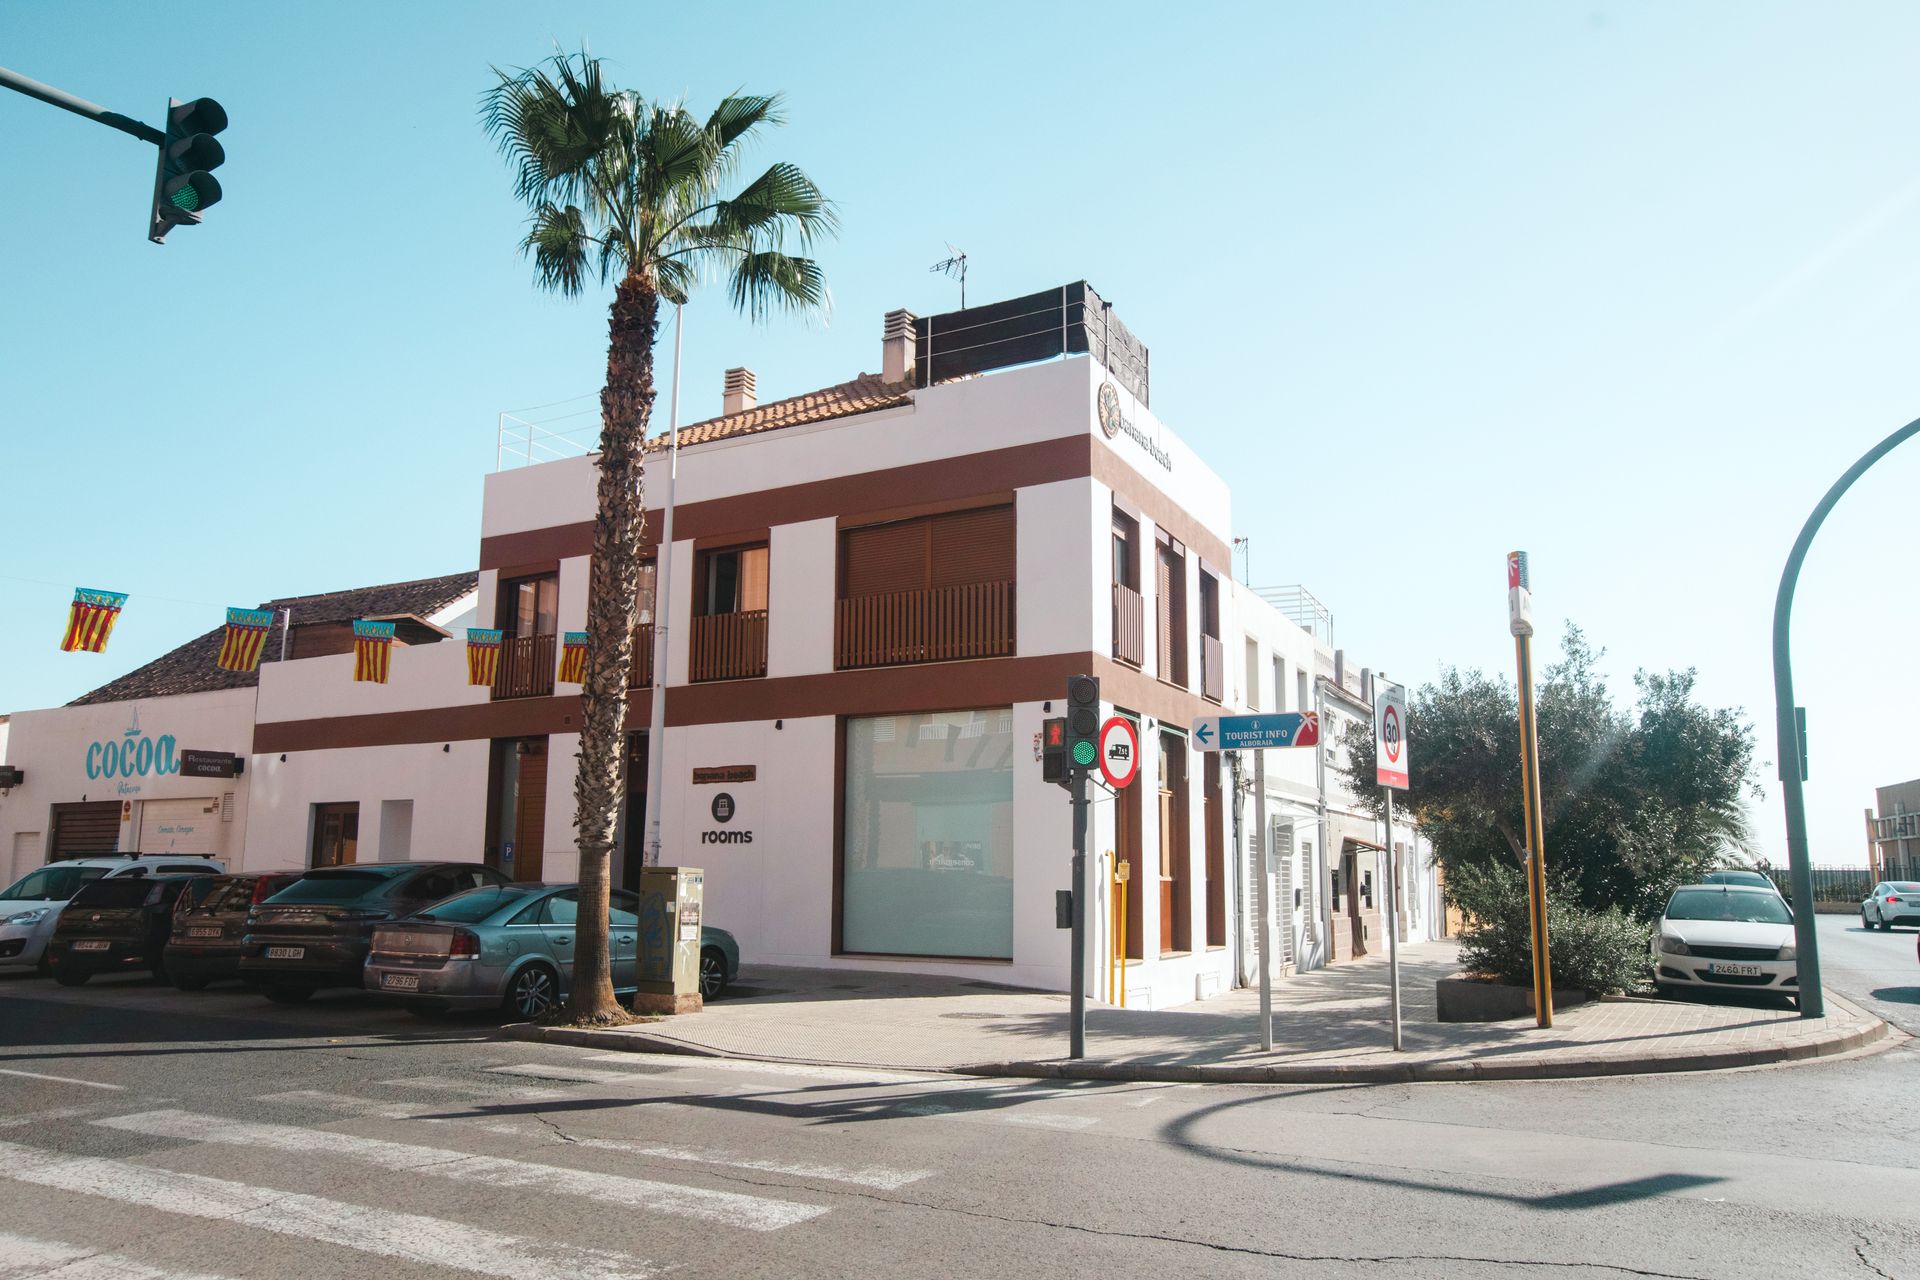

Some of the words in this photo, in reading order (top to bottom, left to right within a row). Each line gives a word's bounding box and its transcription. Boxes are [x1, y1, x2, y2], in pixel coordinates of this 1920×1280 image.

[1225, 731, 1263, 741] TOURIST
[1265, 729, 1288, 739] INFO
[1386, 723, 1398, 745] 30
[1239, 739, 1274, 748] ALBORAIA
[702, 830, 753, 844] rooms
[506, 847, 512, 857] P
[1716, 965, 1739, 974] 2460
[1742, 966, 1758, 975] FRT
